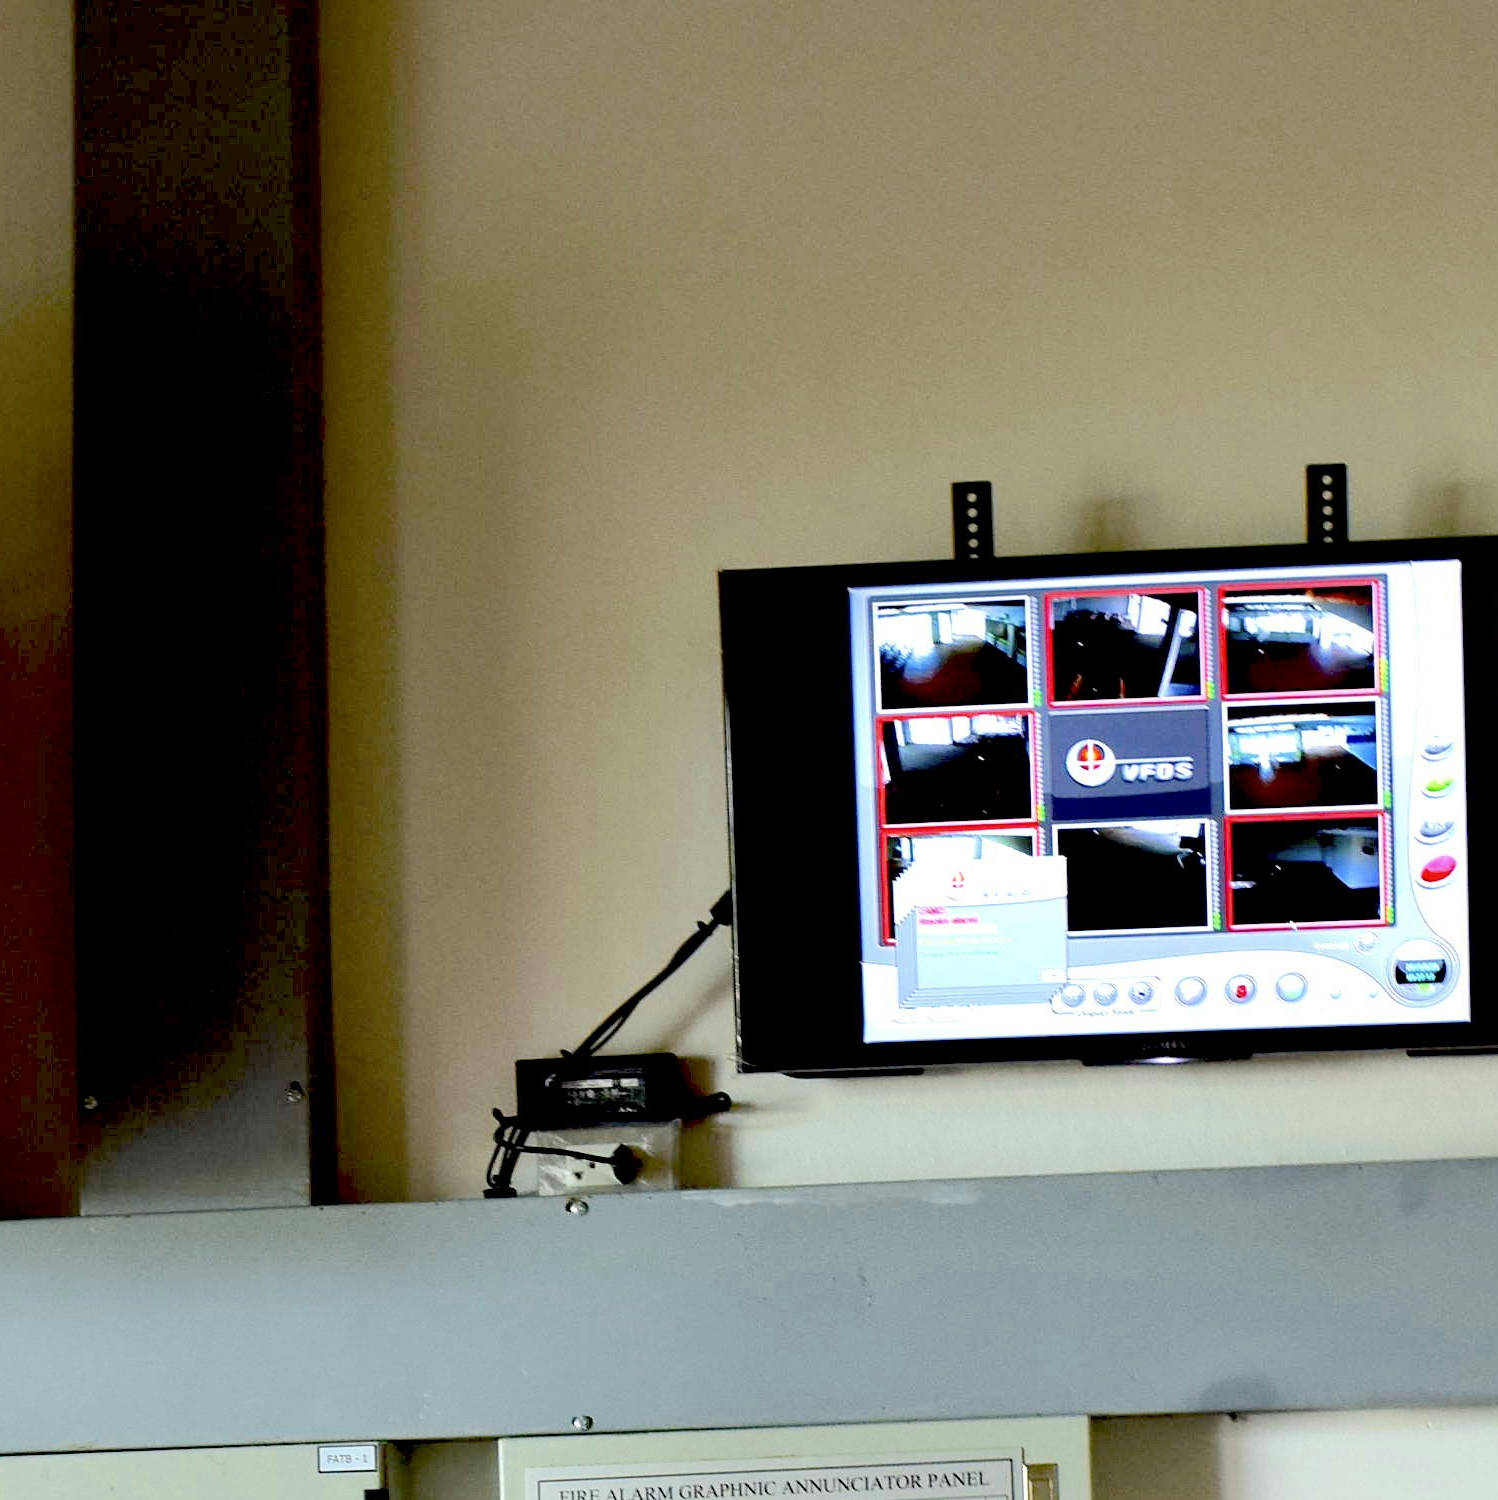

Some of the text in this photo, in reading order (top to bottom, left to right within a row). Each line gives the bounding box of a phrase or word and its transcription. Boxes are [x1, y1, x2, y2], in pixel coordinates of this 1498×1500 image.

[326, 1454, 353, 1464] FATB
[679, 1481, 777, 1500] GRAPHNIC
[782, 1474, 922, 1495] ANNUNCIATOR
[928, 1471, 990, 1488] PANEL
